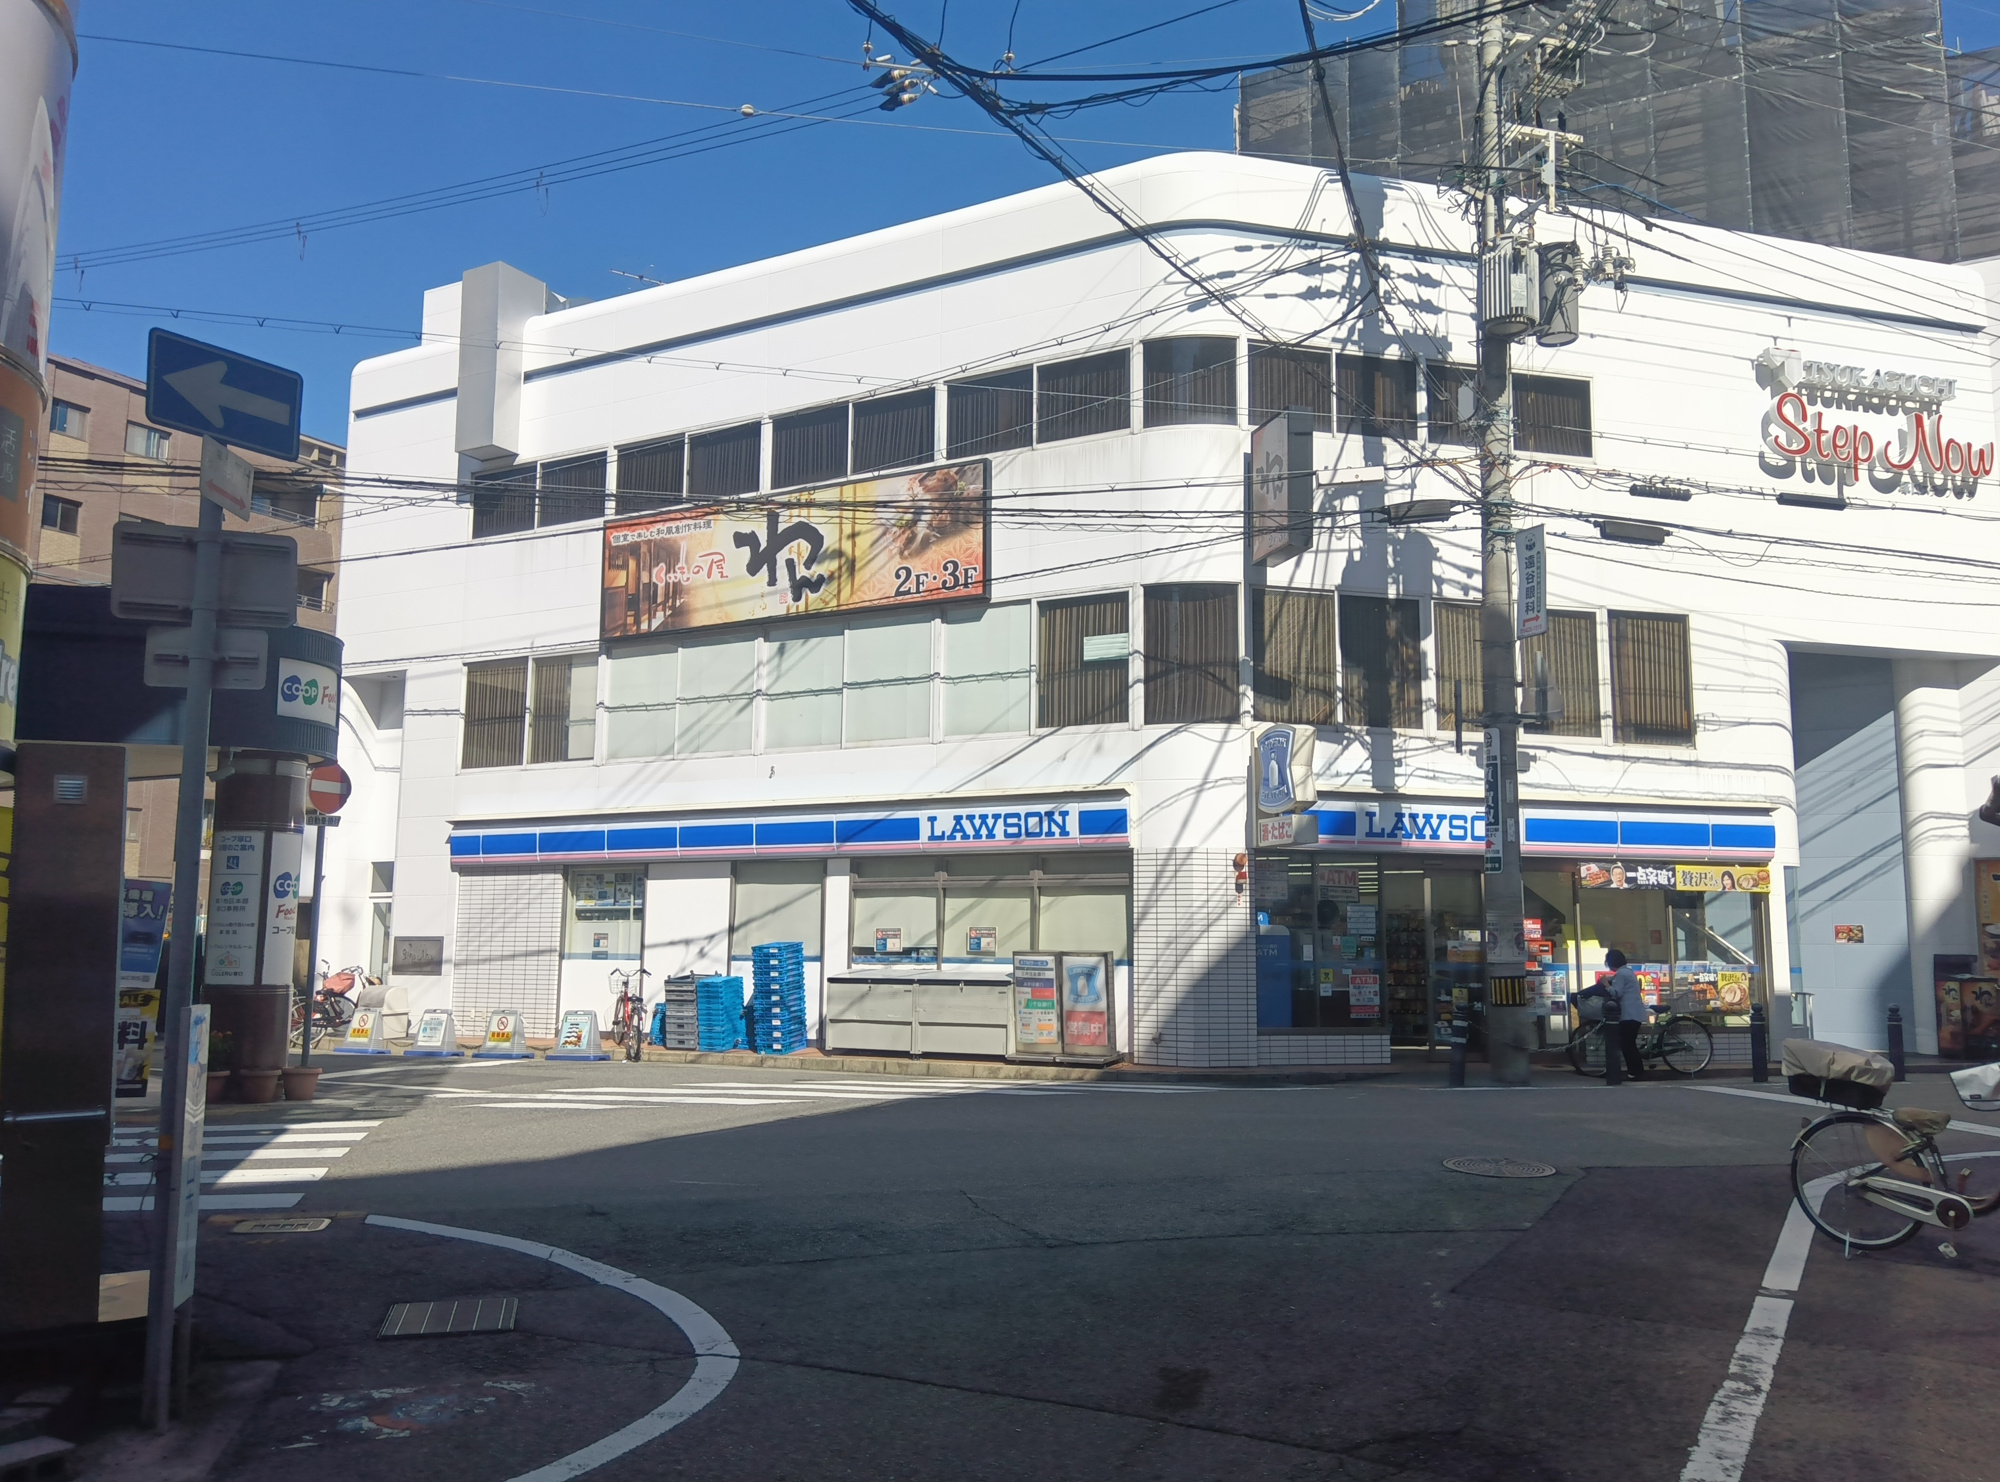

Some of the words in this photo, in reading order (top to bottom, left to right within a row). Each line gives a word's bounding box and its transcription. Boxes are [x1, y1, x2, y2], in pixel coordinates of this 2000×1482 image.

[1803, 360, 1958, 401] TSUKAGUCHI
[1773, 391, 1874, 483] Step
[1883, 412, 1995, 478] Now
[1255, 450, 1285, 501] わん
[732, 508, 828, 604] わん
[927, 810, 1070, 842] LAWSON
[1261, 822, 1292, 842] 酒・たばこ
[1365, 810, 1485, 842] LAWSO
[1257, 949, 1278, 957] ATM
[1355, 976, 1375, 984] ATM
[121, 994, 145, 1005] ALE
[1067, 1020, 1103, 1036] 営業中
